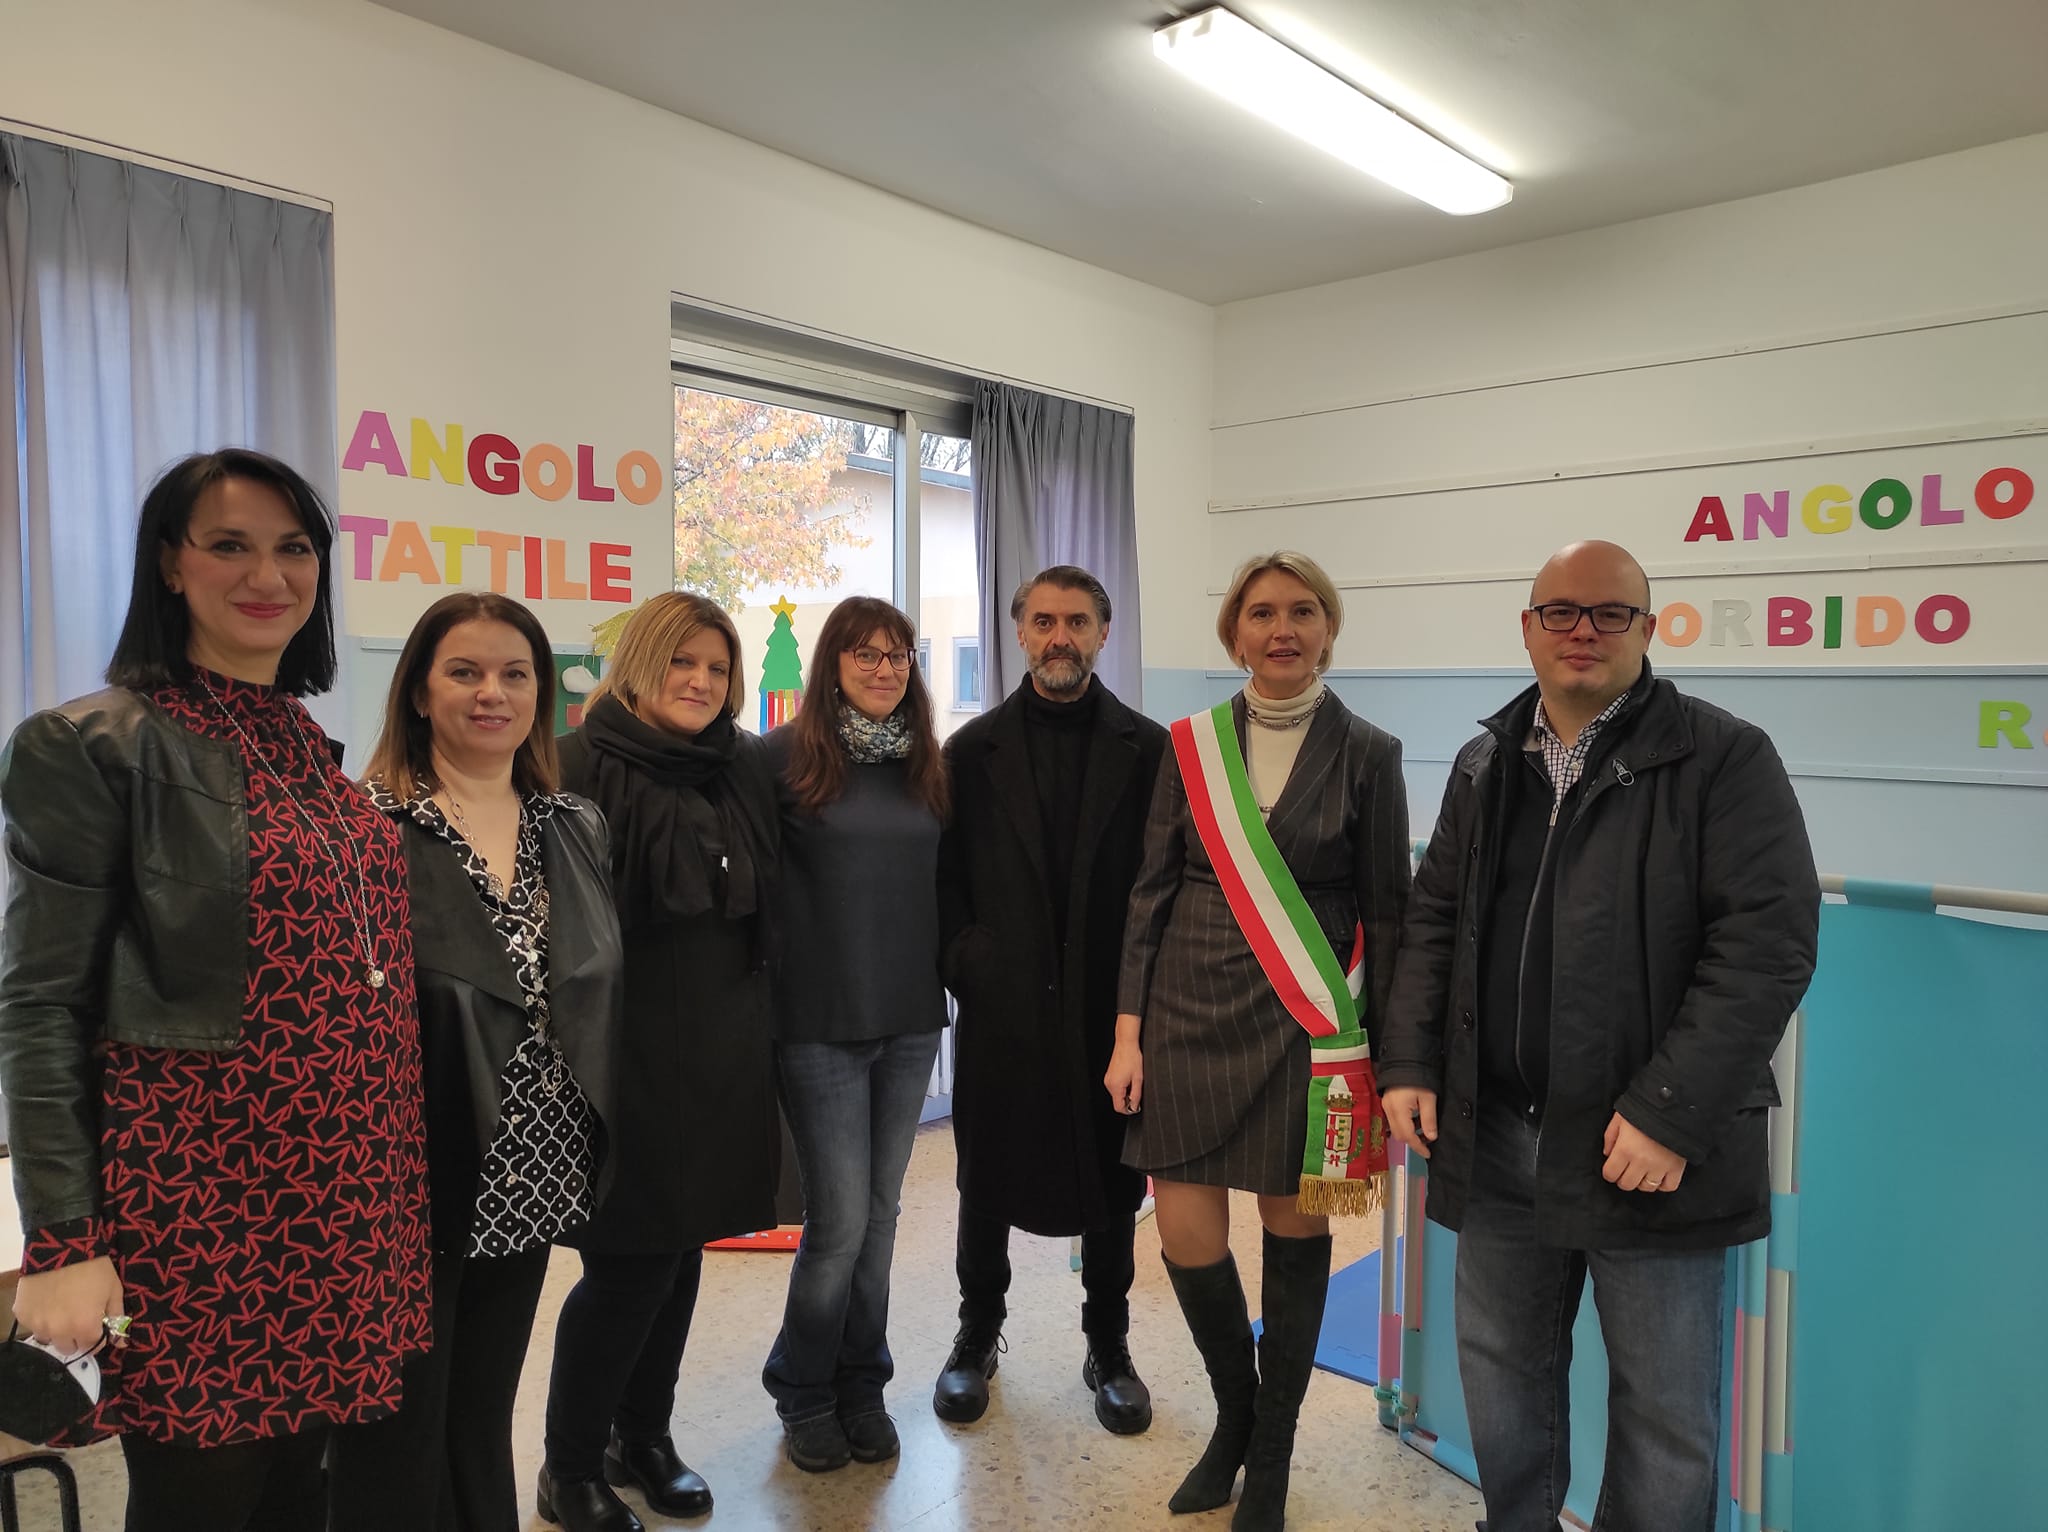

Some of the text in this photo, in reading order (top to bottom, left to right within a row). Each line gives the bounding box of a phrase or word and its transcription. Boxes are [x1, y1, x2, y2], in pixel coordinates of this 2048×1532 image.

[342, 410, 663, 506] ANGOLO
[1684, 467, 2035, 542] ANGOLO
[339, 514, 632, 603] TATTILE
[1657, 594, 1971, 649] ORBIDO
